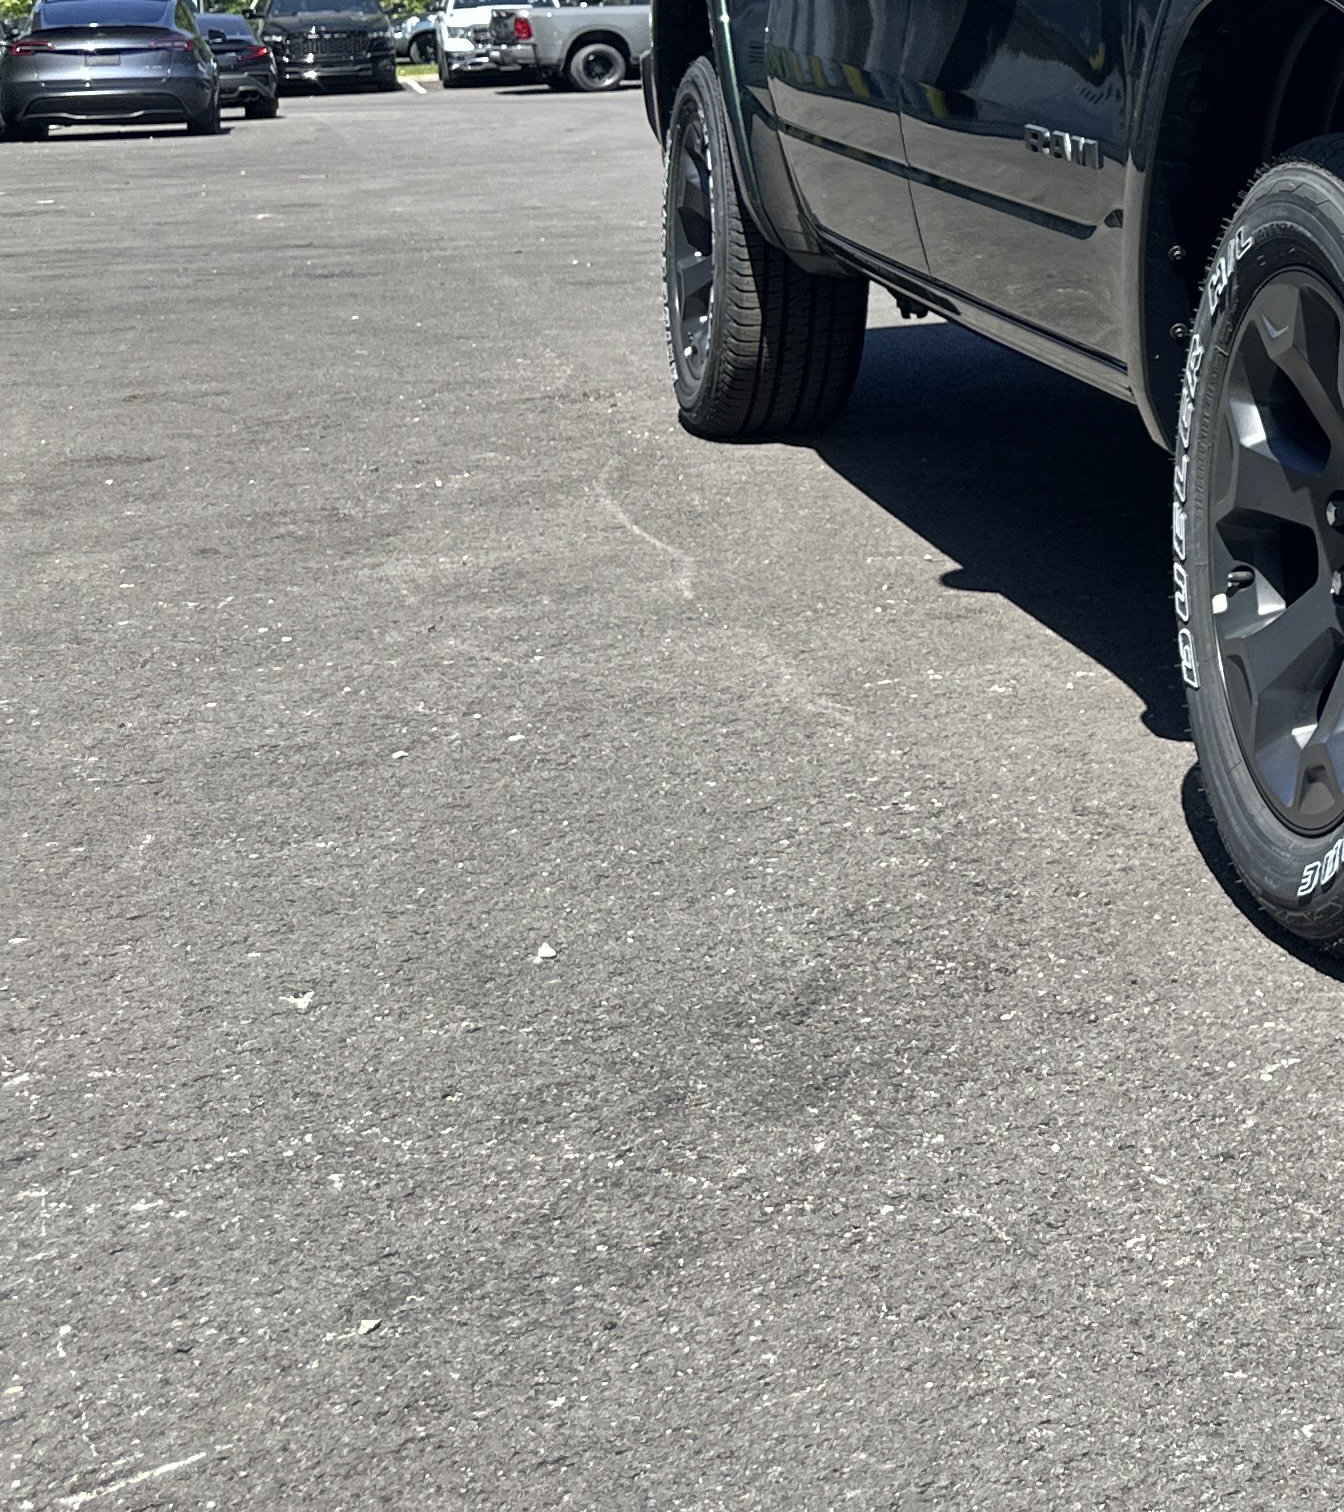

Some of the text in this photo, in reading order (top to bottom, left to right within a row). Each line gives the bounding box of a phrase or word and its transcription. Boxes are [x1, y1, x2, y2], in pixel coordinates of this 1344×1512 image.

[1024, 123, 1103, 170] RAM
[1172, 333, 1204, 689] DUELER
[1208, 225, 1254, 316] H/L
